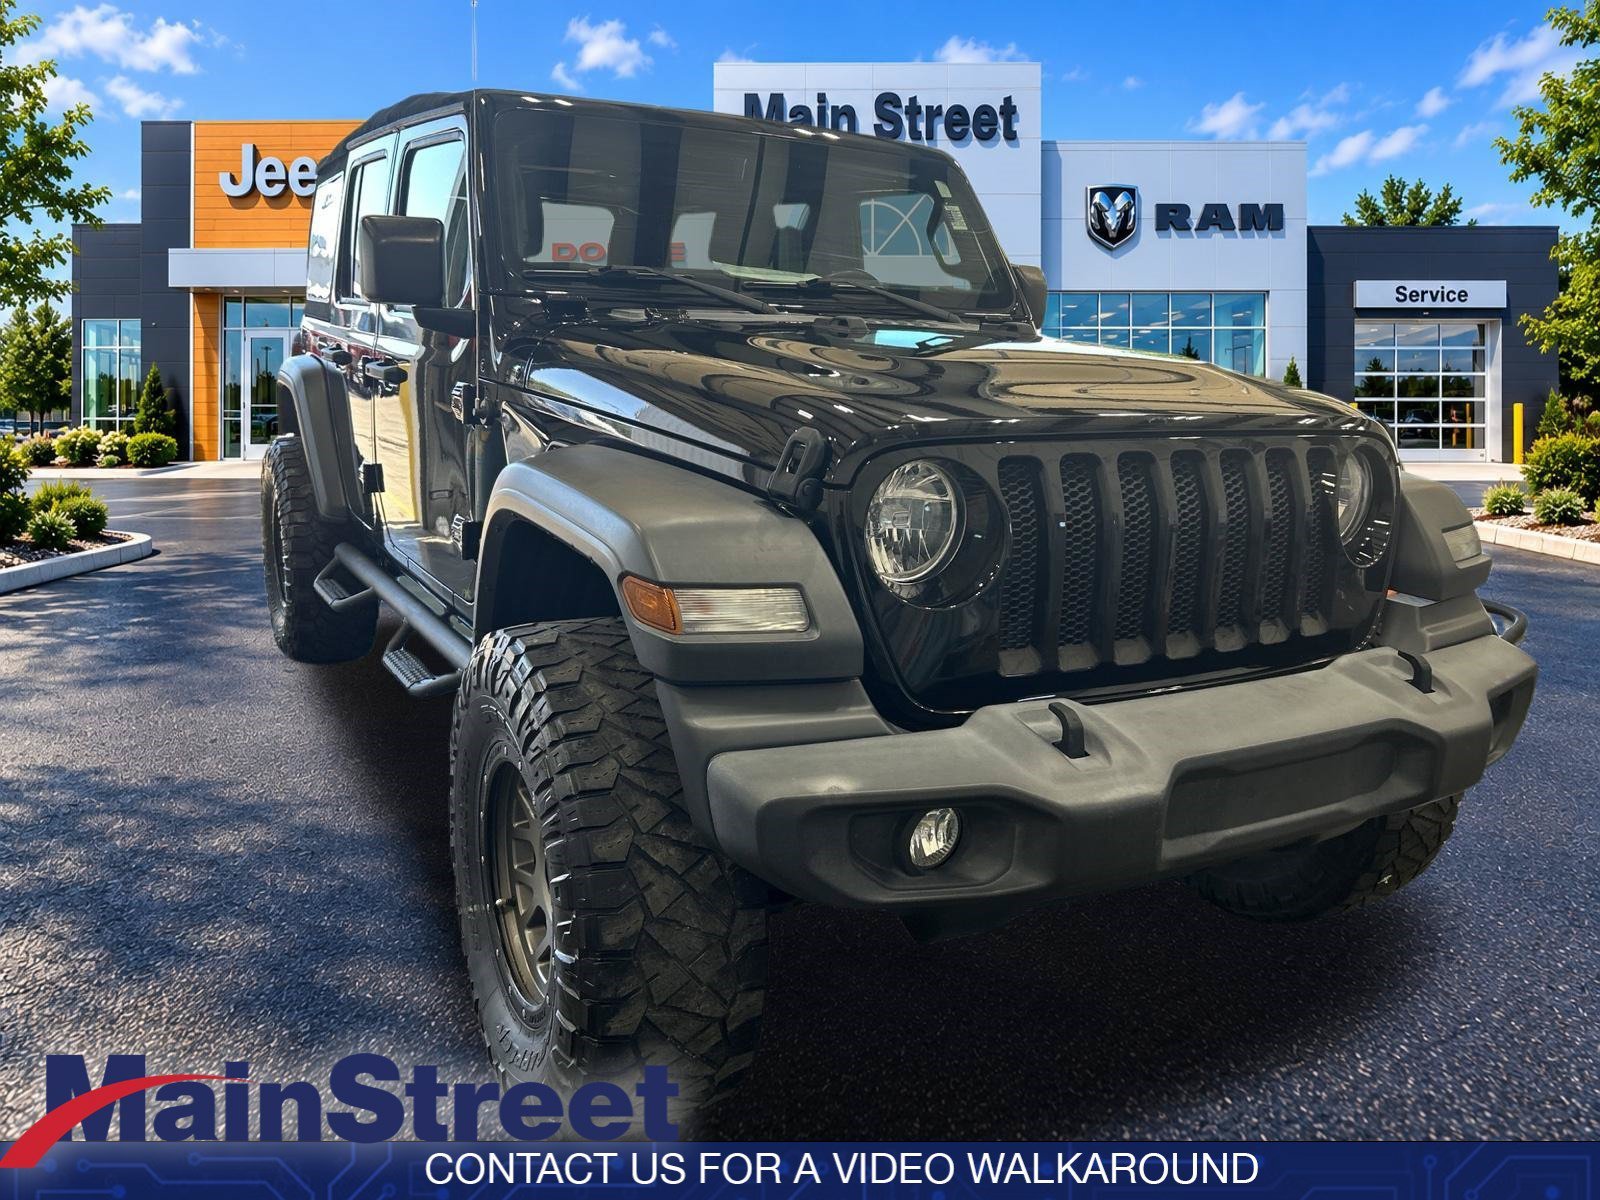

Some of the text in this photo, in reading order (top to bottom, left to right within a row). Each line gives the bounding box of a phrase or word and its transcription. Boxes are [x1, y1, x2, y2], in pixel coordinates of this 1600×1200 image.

[744, 92, 1018, 140] Main Street
[219, 143, 318, 197] Jee
[1155, 203, 1284, 231] RAM
[1395, 285, 1469, 303] Service
